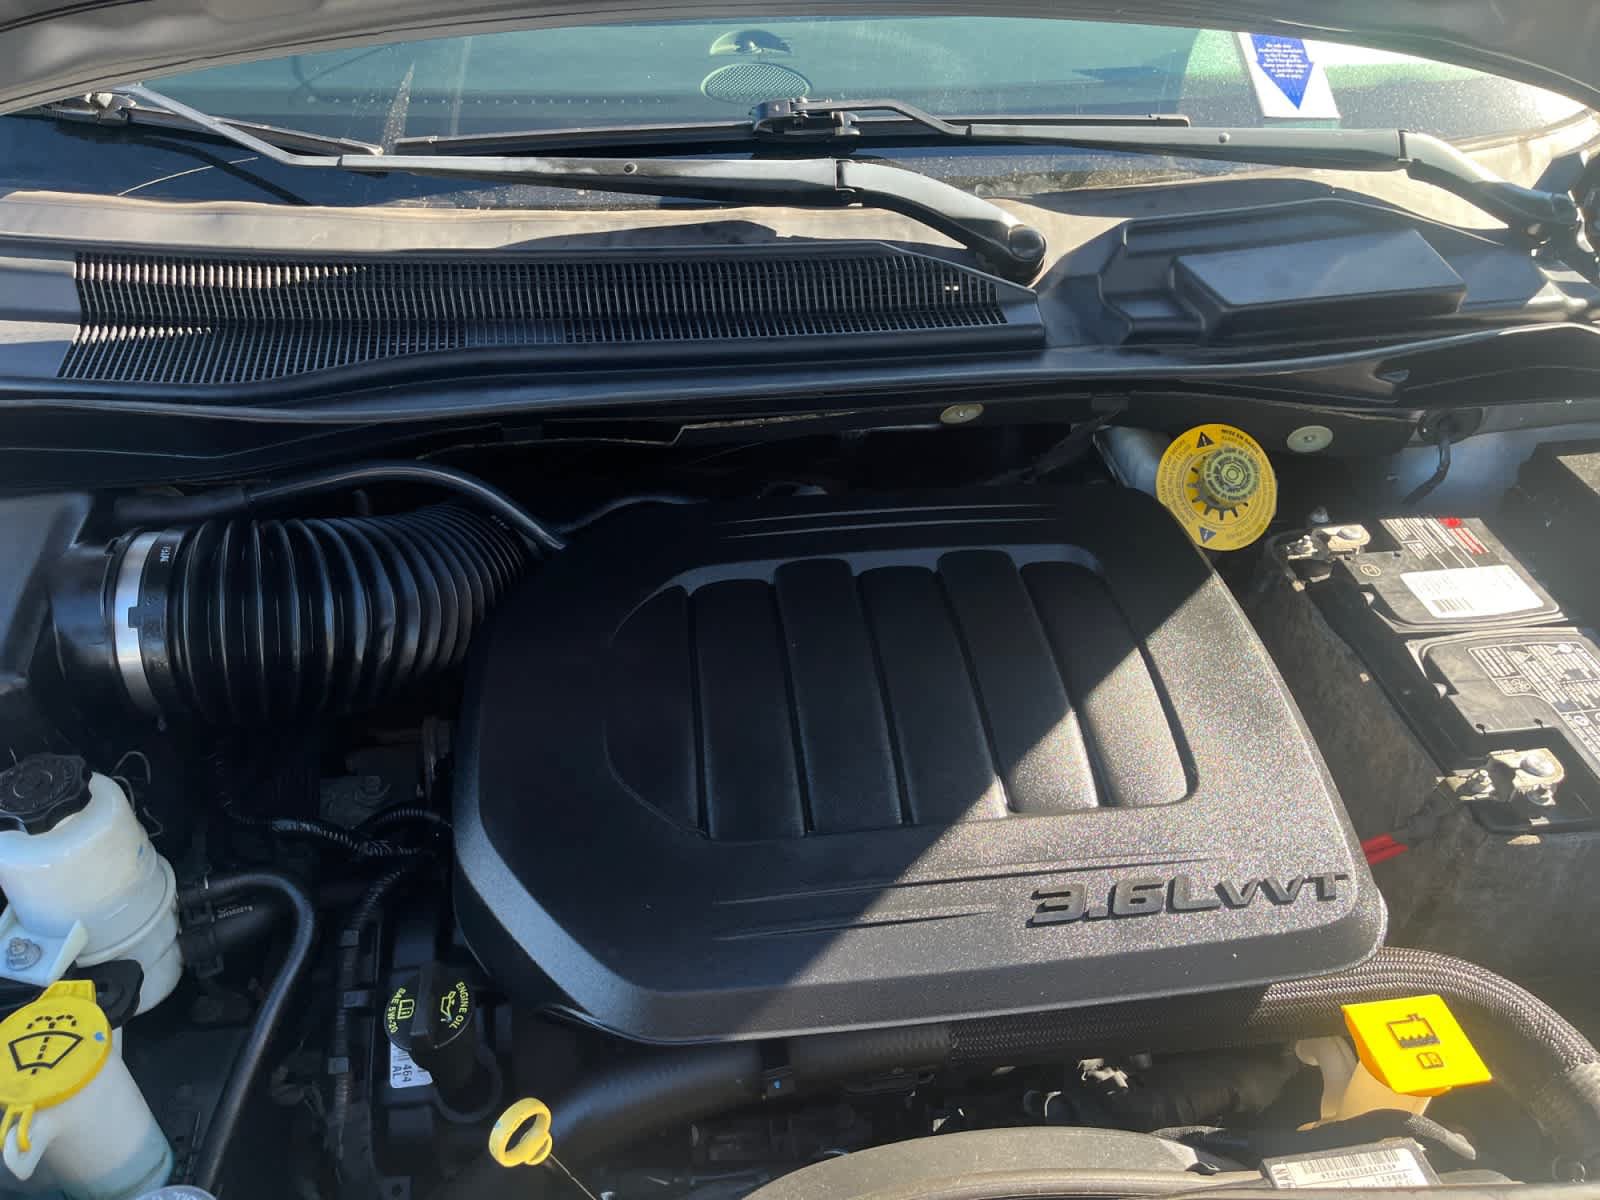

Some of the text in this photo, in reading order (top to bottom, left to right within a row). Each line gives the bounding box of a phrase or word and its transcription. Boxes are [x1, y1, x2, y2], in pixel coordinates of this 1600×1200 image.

[449, 981, 470, 1030] ENGINE OIL
[387, 1006, 399, 1033] 5W-20
[392, 1065, 402, 1079] AL
[402, 1064, 413, 1082] 464
